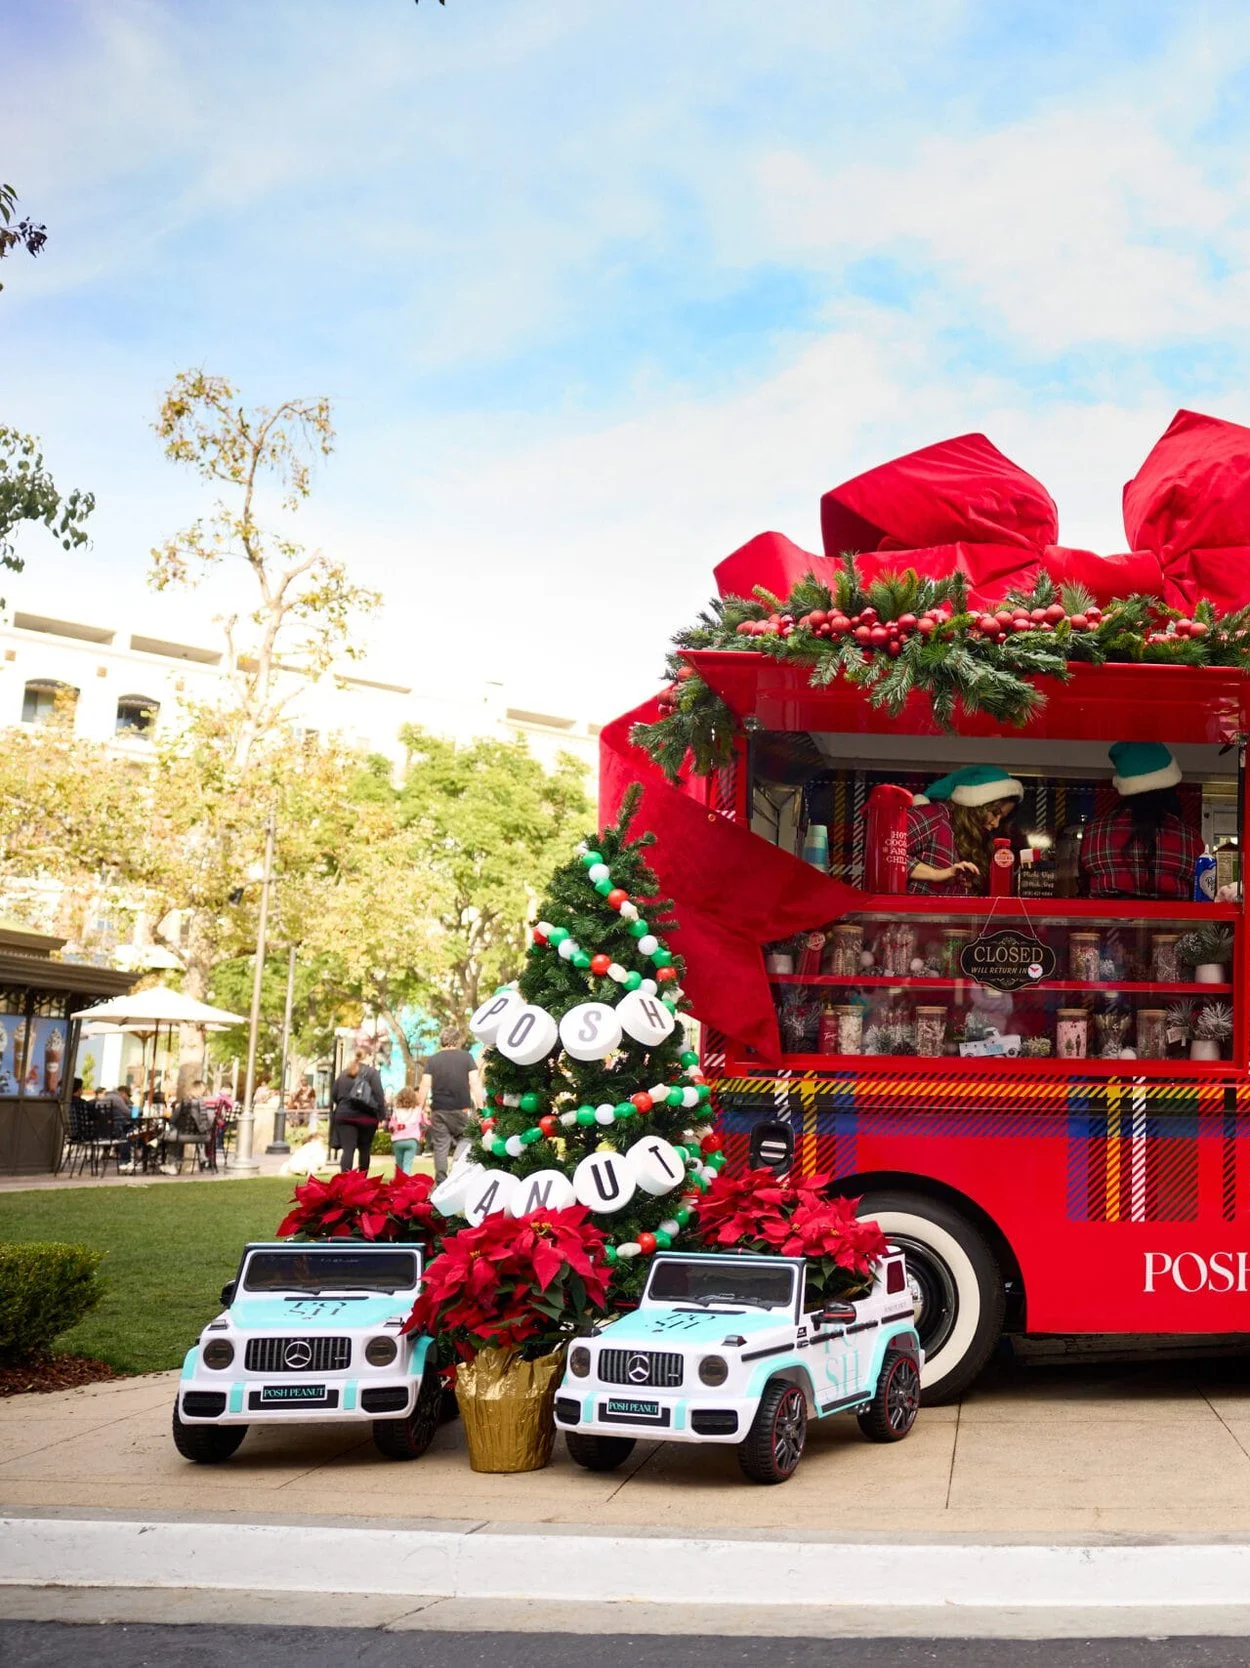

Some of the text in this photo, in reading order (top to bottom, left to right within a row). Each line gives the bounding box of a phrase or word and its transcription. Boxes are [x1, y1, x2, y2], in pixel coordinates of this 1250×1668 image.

[974, 946, 1043, 963] CLOSED
[971, 966, 988, 974] WILL
[990, 966, 1017, 974] RETURN
[477, 998, 665, 1047] POSH
[436, 1142, 675, 1217] ANUT
[263, 1387, 324, 1397] POSH PEANUT
[609, 1402, 658, 1413] POSH PEANUT
